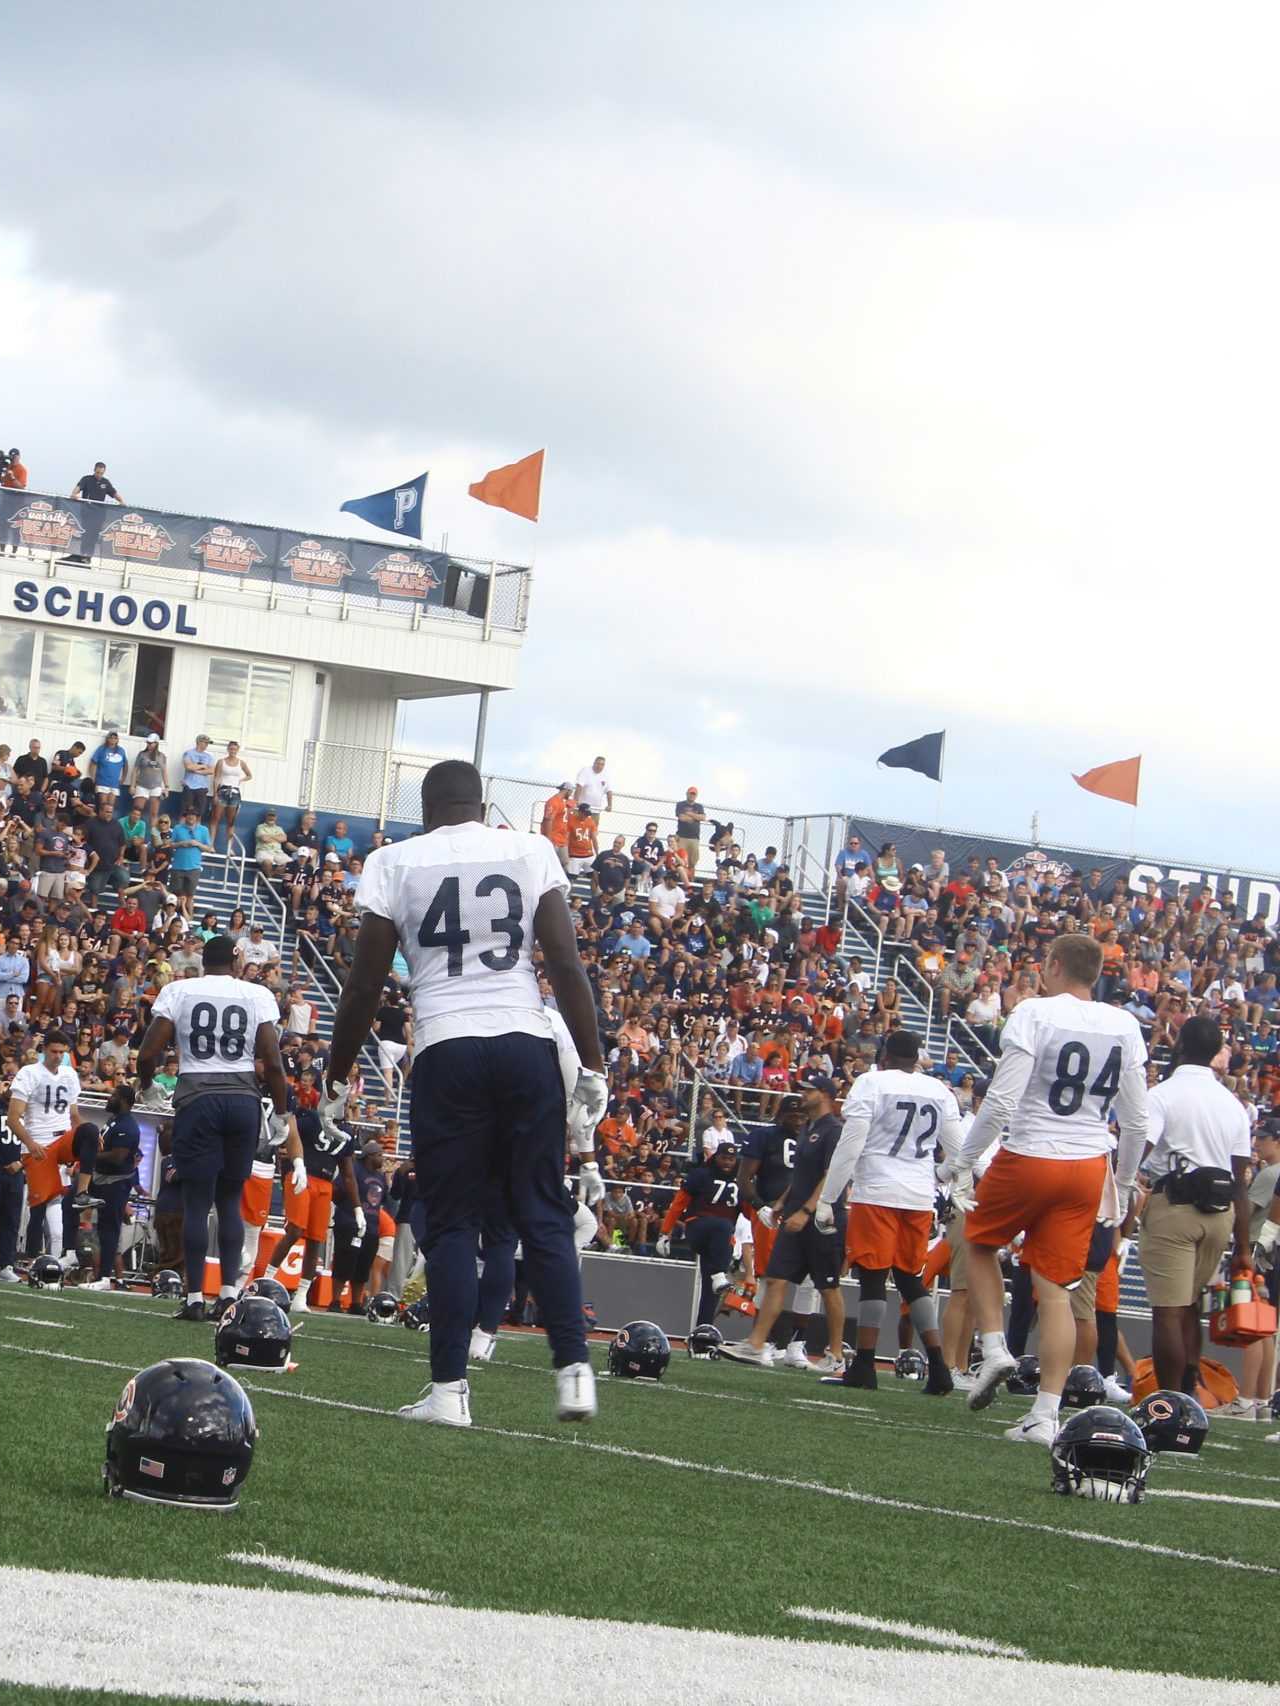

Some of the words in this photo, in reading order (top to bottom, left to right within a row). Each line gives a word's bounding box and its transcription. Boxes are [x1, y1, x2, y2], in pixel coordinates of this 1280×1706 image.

[394, 487, 417, 528] P
[28, 510, 70, 527] varsity
[21, 520, 72, 539] BEARS
[120, 524, 158, 540] varsity
[115, 532, 162, 552] BEARS
[211, 536, 248, 552] varsity
[206, 544, 252, 565] BEARS
[299, 550, 337, 565] varsity
[293, 558, 341, 578] BEARS
[386, 562, 426, 577] varsity
[380, 571, 429, 591] BEARS
[13, 580, 197, 636] SCHOOL
[575, 827, 590, 842] 54
[418, 874, 524, 977] 43
[189, 1002, 248, 1061] 88
[1048, 1040, 1122, 1120] 84
[43, 1085, 69, 1114] 16
[889, 1102, 938, 1159] 72
[711, 1179, 739, 1207] 73
